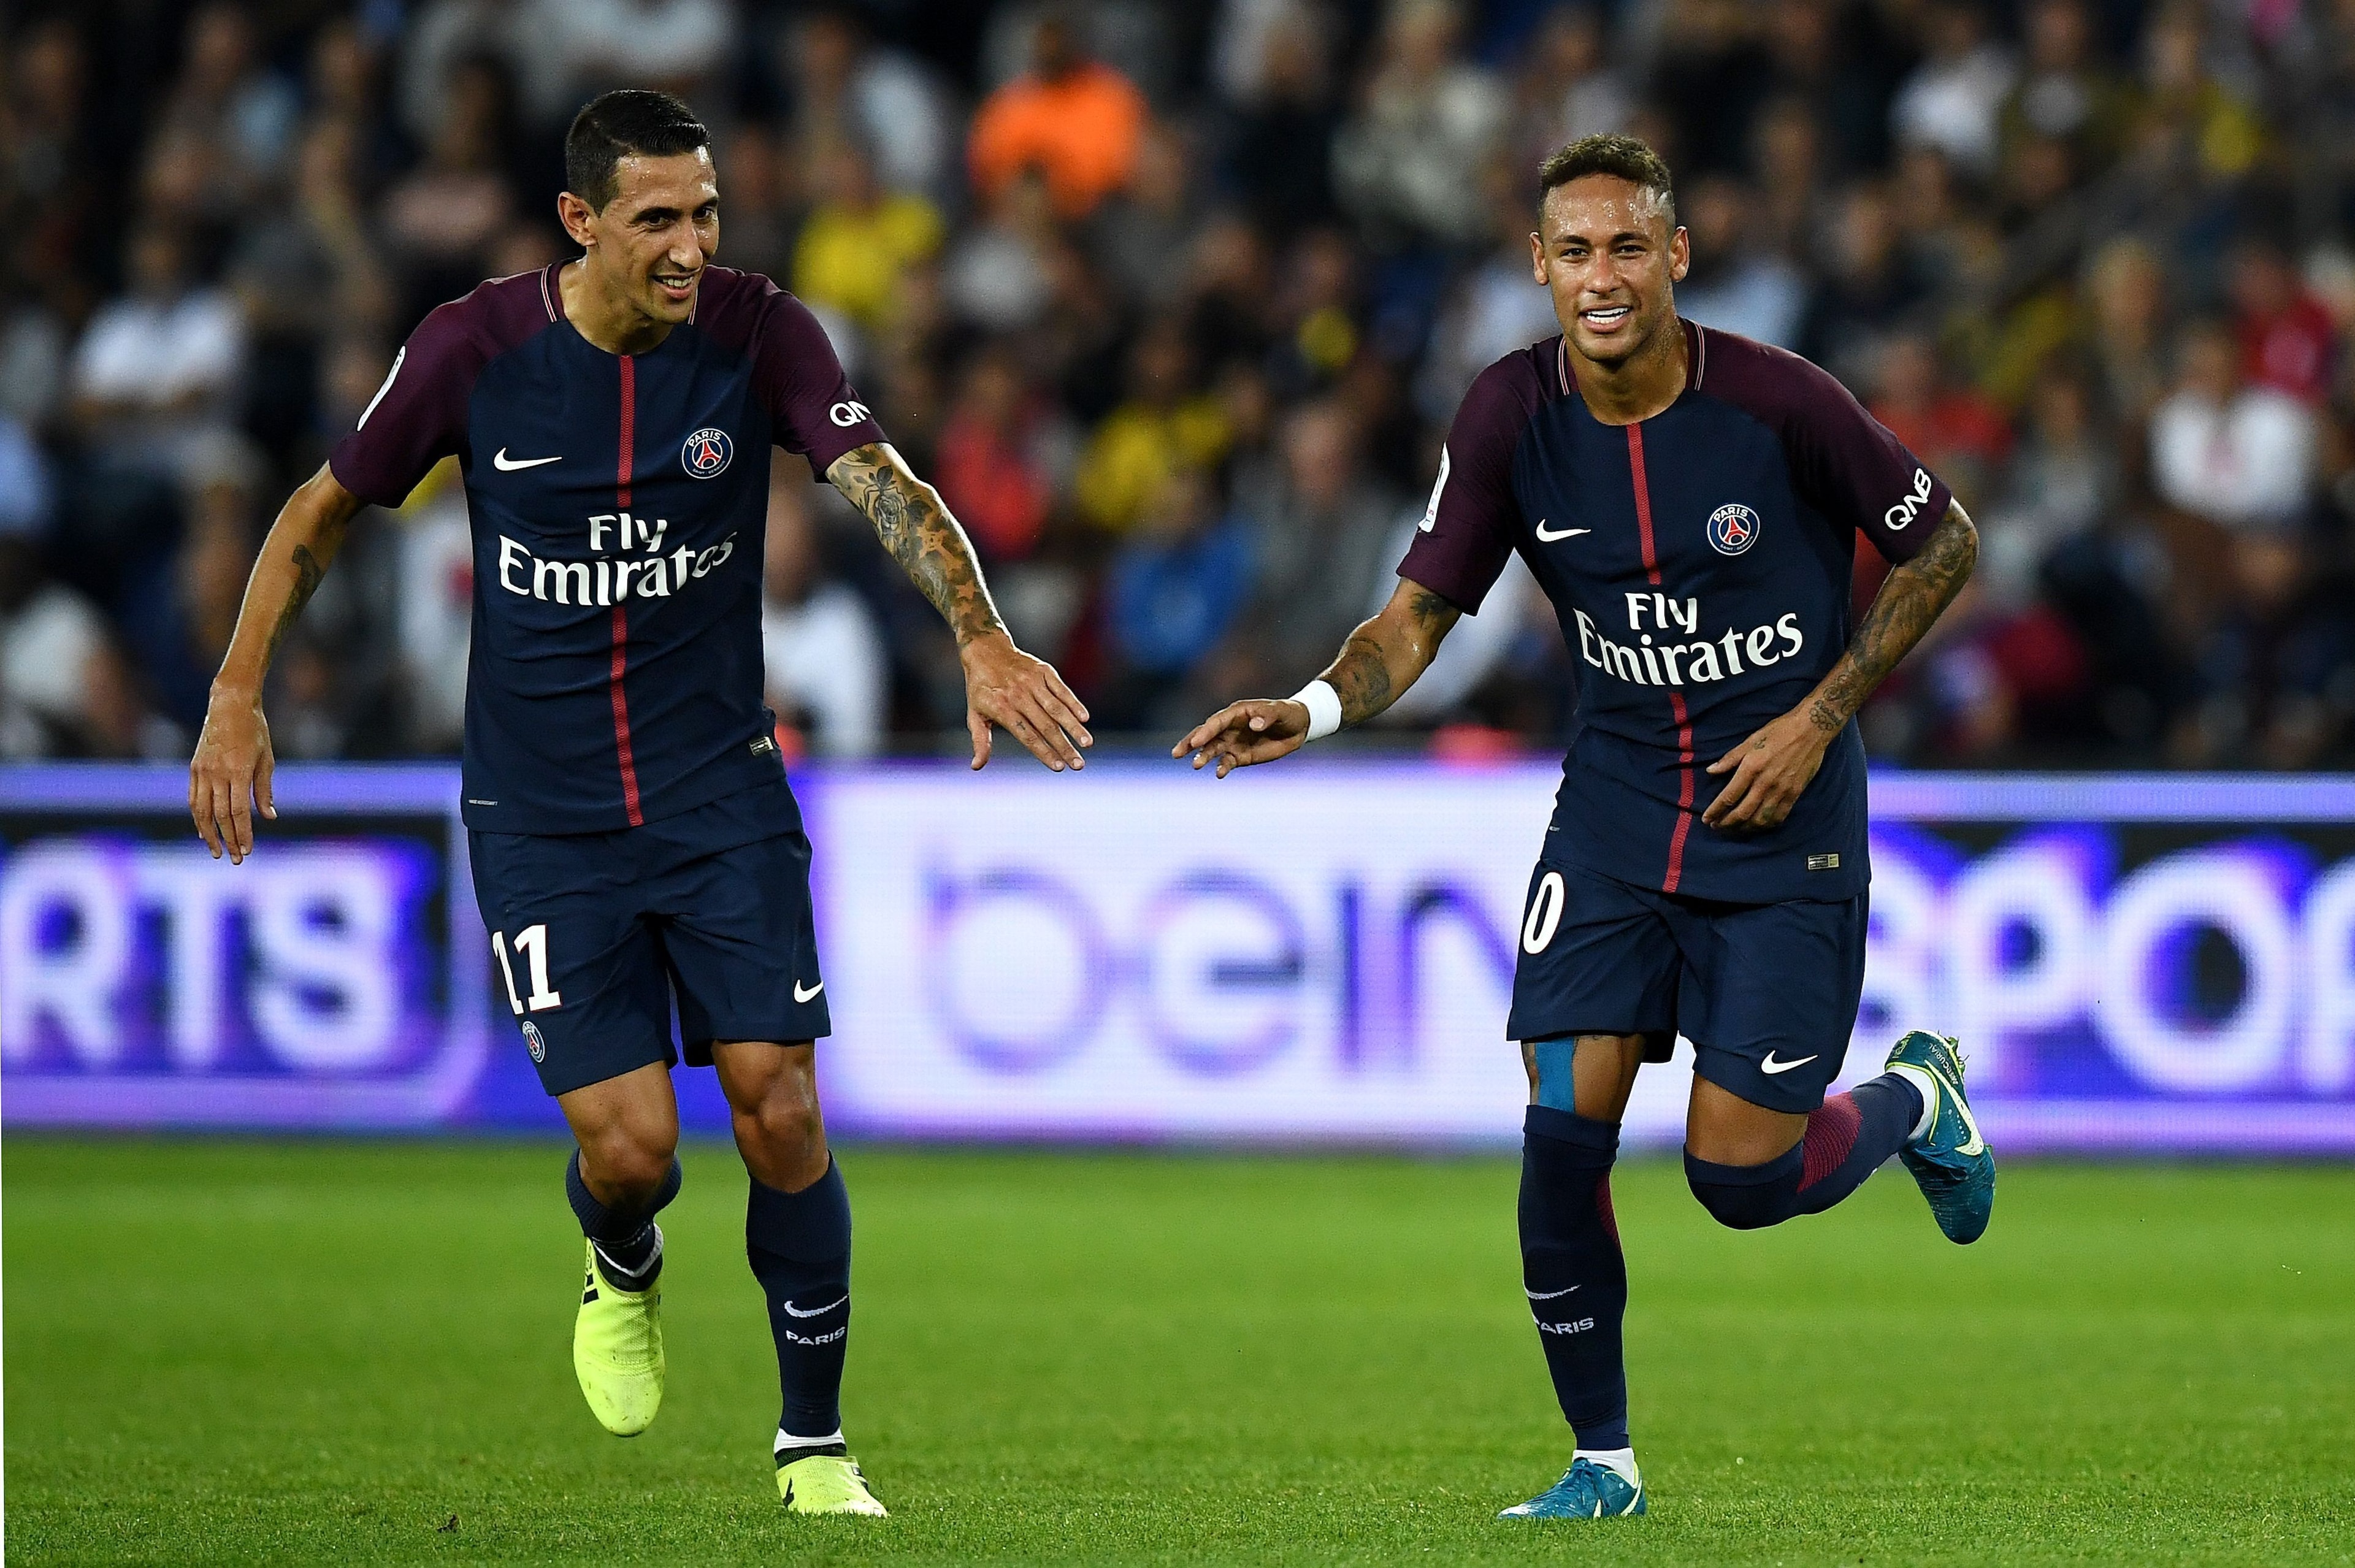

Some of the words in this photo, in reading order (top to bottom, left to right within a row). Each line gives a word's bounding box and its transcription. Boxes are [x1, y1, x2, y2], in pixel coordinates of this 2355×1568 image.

[688, 430, 721, 447] PARIS
[1713, 507, 1748, 522] PARIS
[1885, 468, 1932, 530] QNB
[588, 513, 667, 552] Fly
[499, 531, 737, 606] Emirates
[1625, 592, 1697, 634] Fly
[1572, 608, 1803, 686] Emirates
[1523, 871, 1565, 954] 0
[492, 924, 563, 1015] 11
[786, 1326, 846, 1345] PARIS
[1533, 1314, 1594, 1335] ARIS
